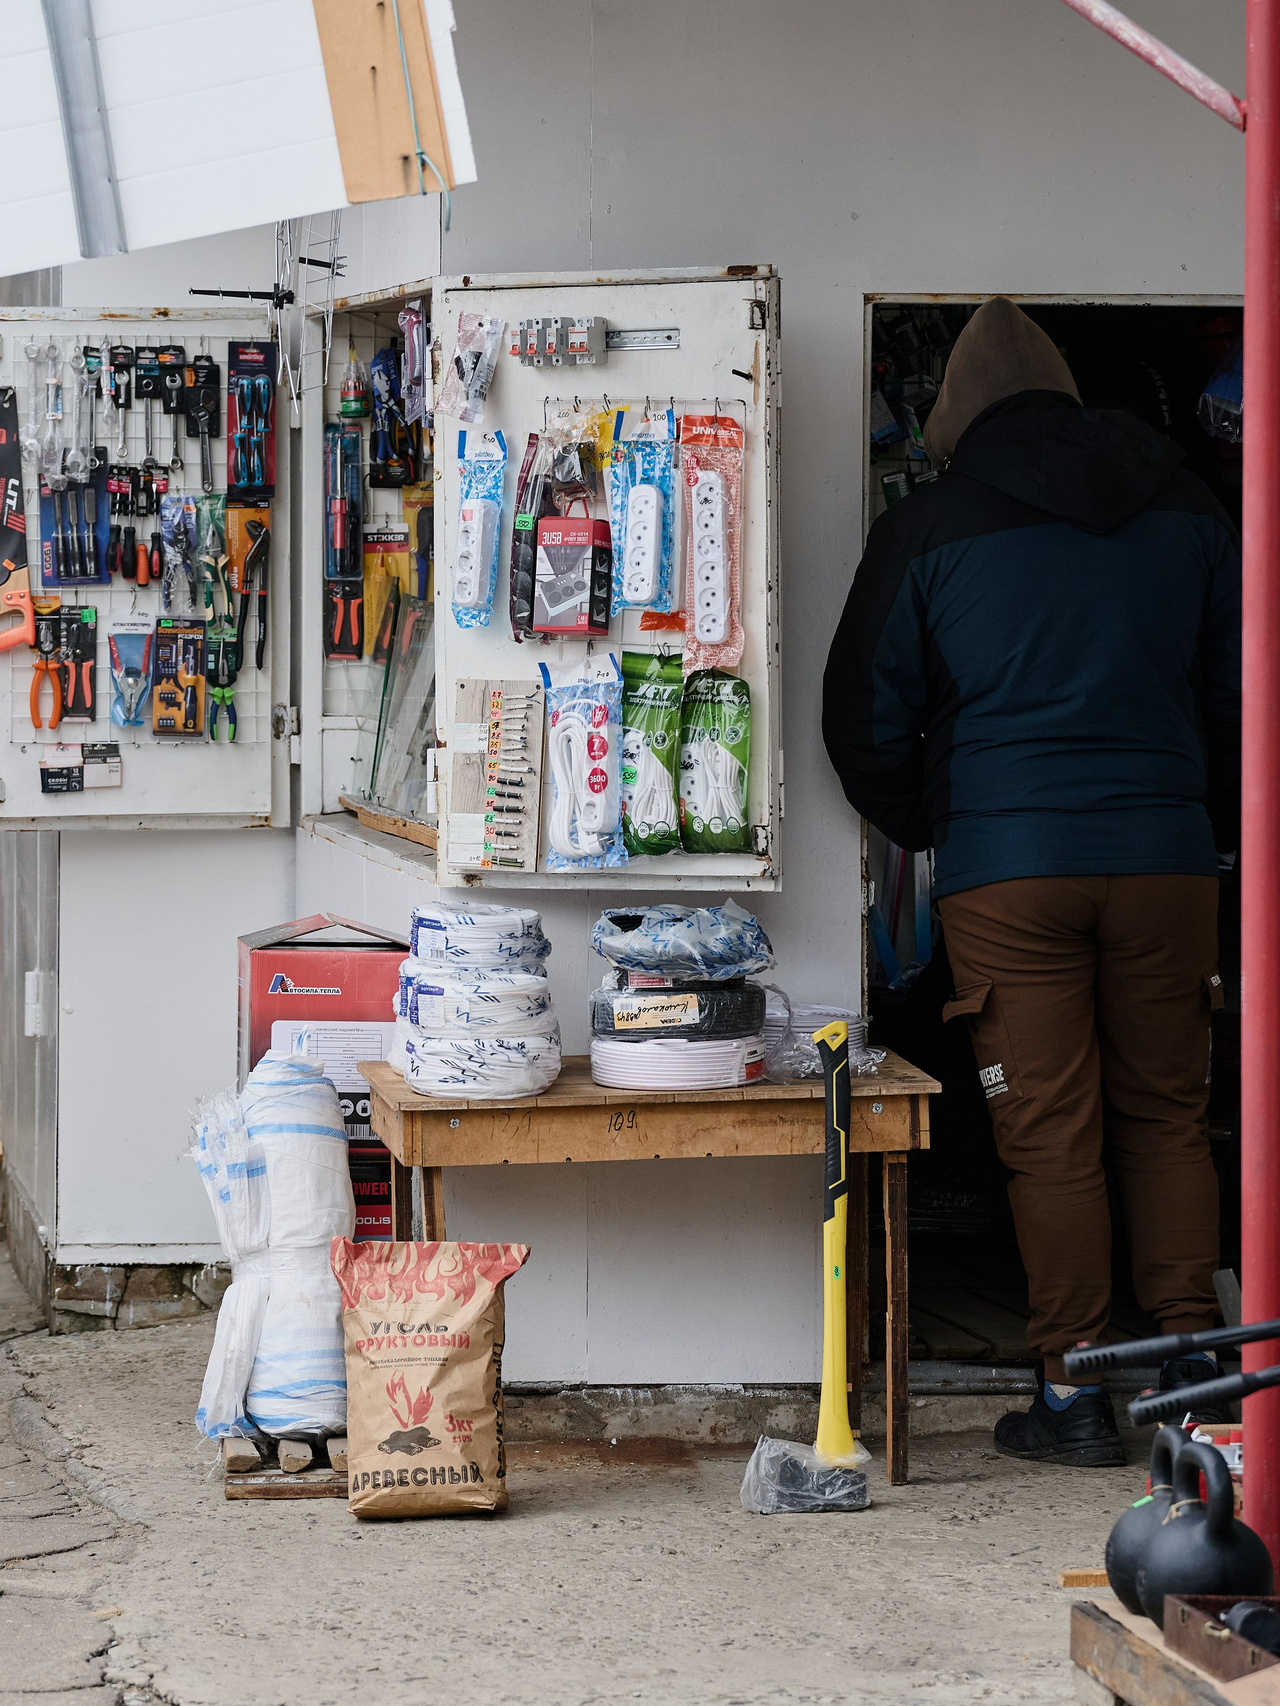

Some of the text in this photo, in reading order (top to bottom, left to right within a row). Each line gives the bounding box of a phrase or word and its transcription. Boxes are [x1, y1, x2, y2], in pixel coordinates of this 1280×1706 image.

[367, 534, 405, 542] STEKKER
[593, 738, 600, 751] 7
[589, 773, 607, 784] 3600
[485, 826, 495, 835] 30
[352, 1181, 389, 1196] OWER
[355, 1216, 391, 1225] OOLiS
[369, 1320, 449, 1336] УГОЛЬ
[355, 1330, 471, 1353] ФРУКТОВЫЙ
[352, 1460, 484, 1493] ДРЕВЕСНЫЙ
